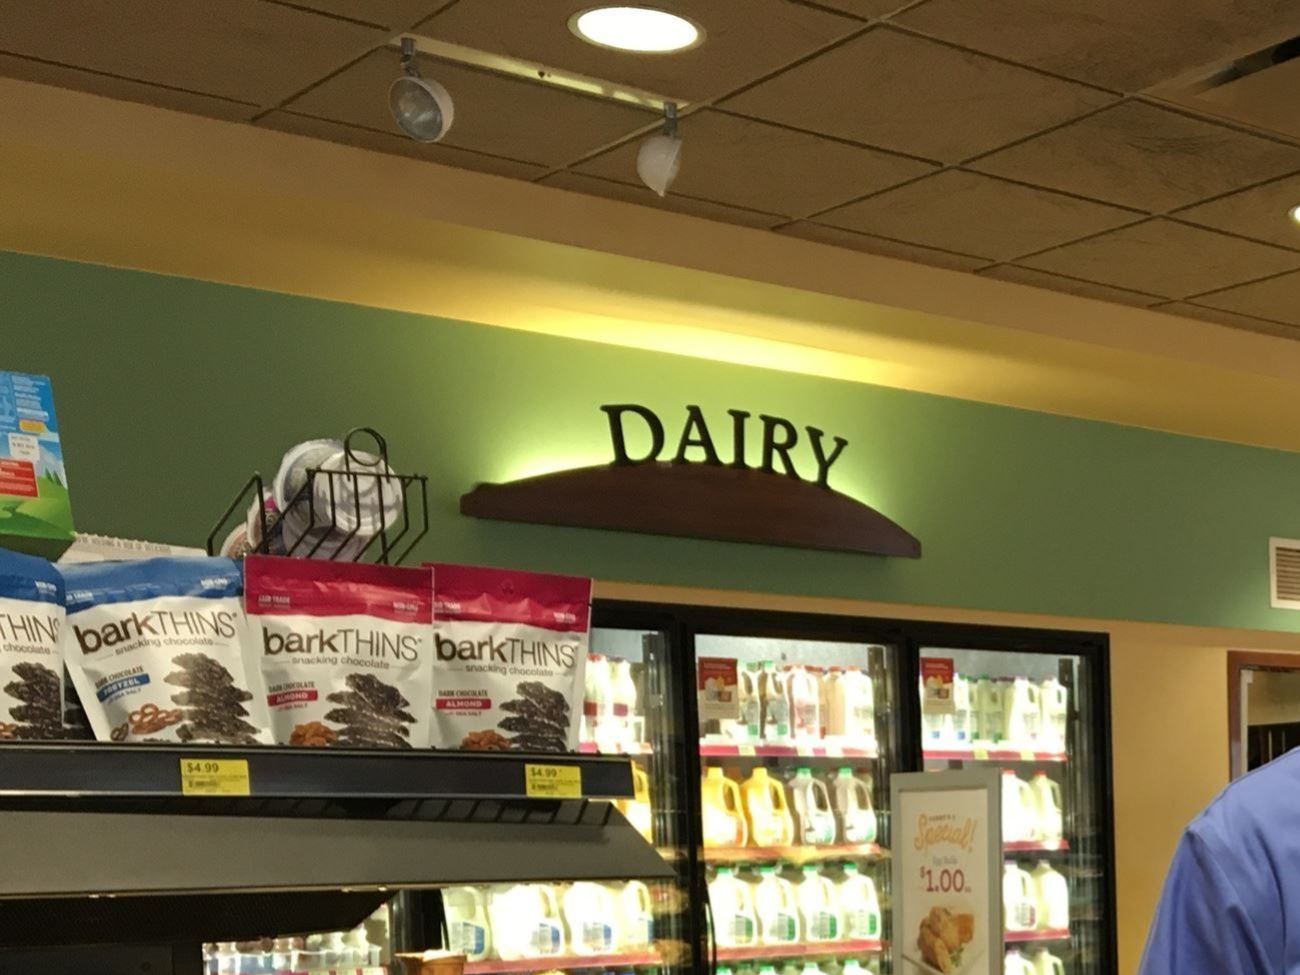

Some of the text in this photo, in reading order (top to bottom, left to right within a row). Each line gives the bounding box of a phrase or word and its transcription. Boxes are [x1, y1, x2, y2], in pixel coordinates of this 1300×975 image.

[600, 404, 849, 489] DAIRY
[115, 637, 213, 655] snacking chocolate
[292, 655, 390, 669] snacking chocolate
[465, 664, 553, 677] snacking chocolate
[187, 762, 219, 774] $4.99
[531, 767, 557, 778] $4.99
